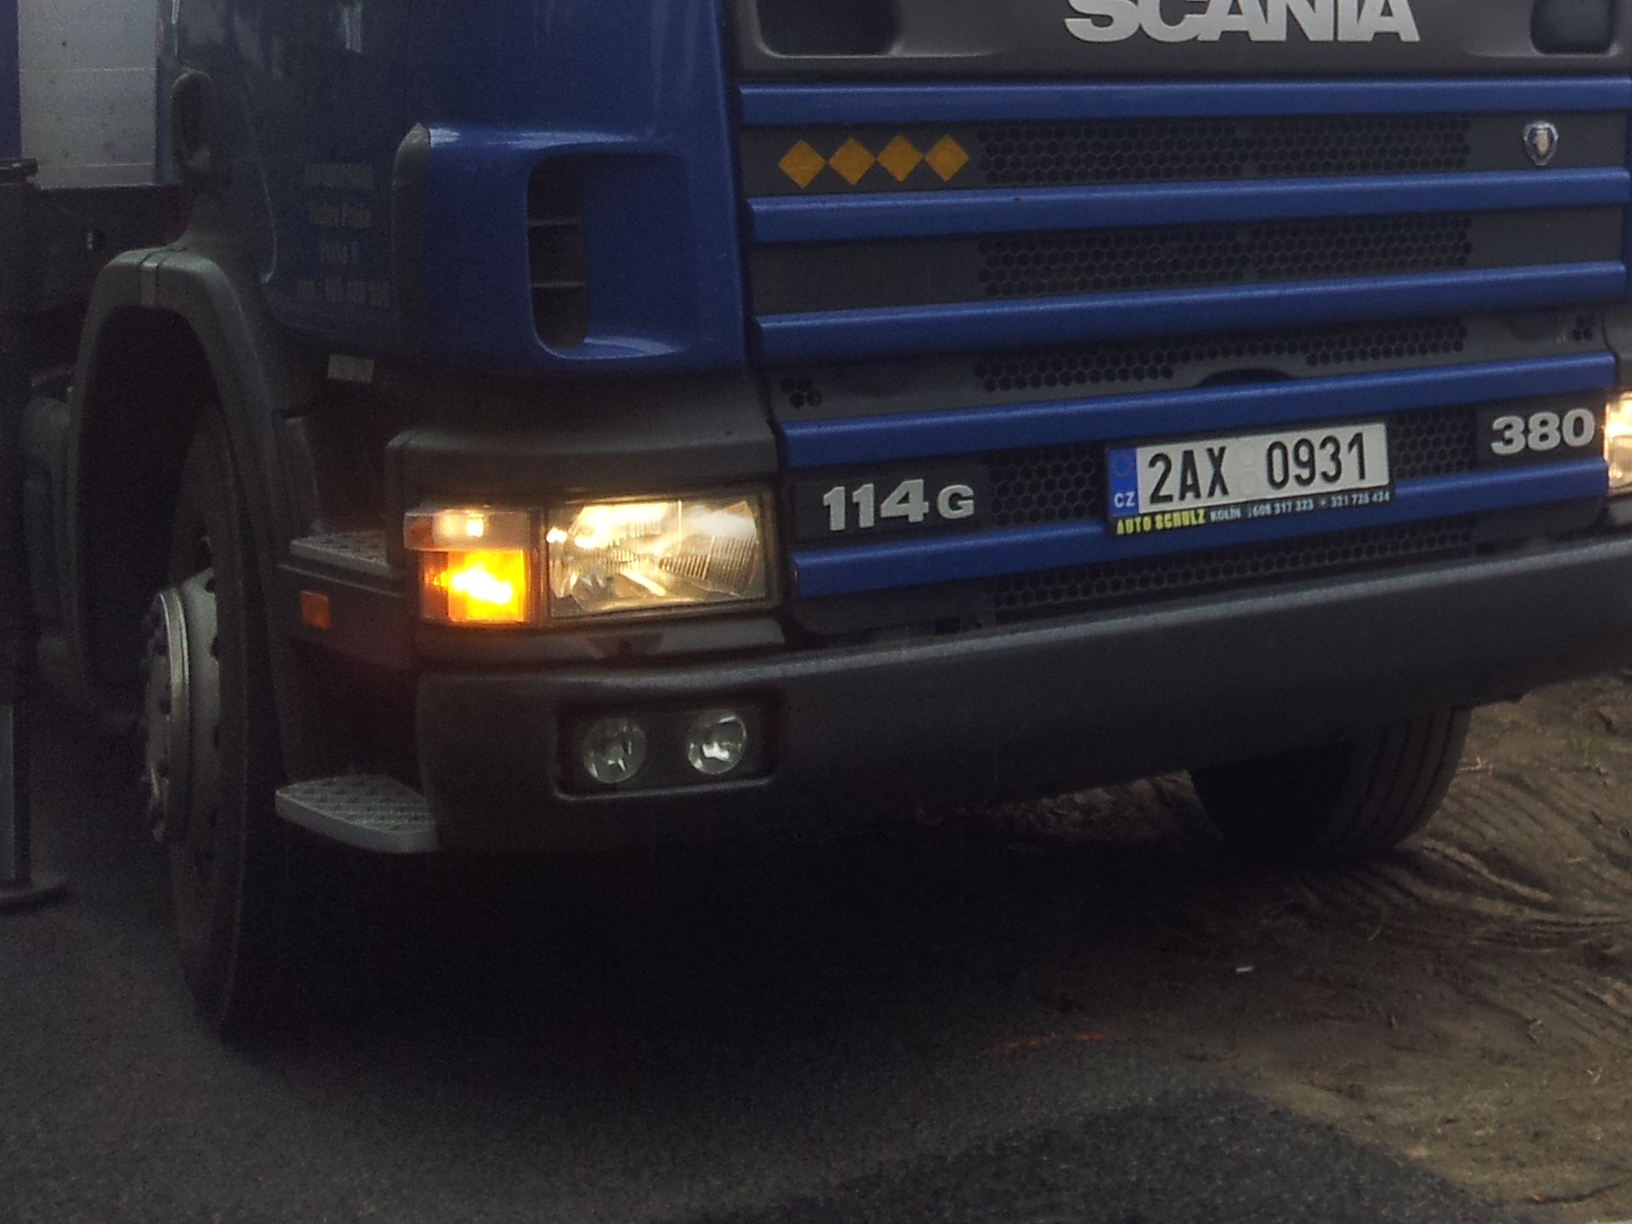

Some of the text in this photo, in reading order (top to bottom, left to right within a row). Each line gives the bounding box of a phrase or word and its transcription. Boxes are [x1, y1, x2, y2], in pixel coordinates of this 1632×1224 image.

[1490, 407, 1596, 456] 380
[1148, 431, 1367, 505] 2AX 0931
[1113, 490, 1137, 509] CZ
[1116, 515, 1153, 535] AUTO
[1154, 508, 1207, 531] SCHULZ
